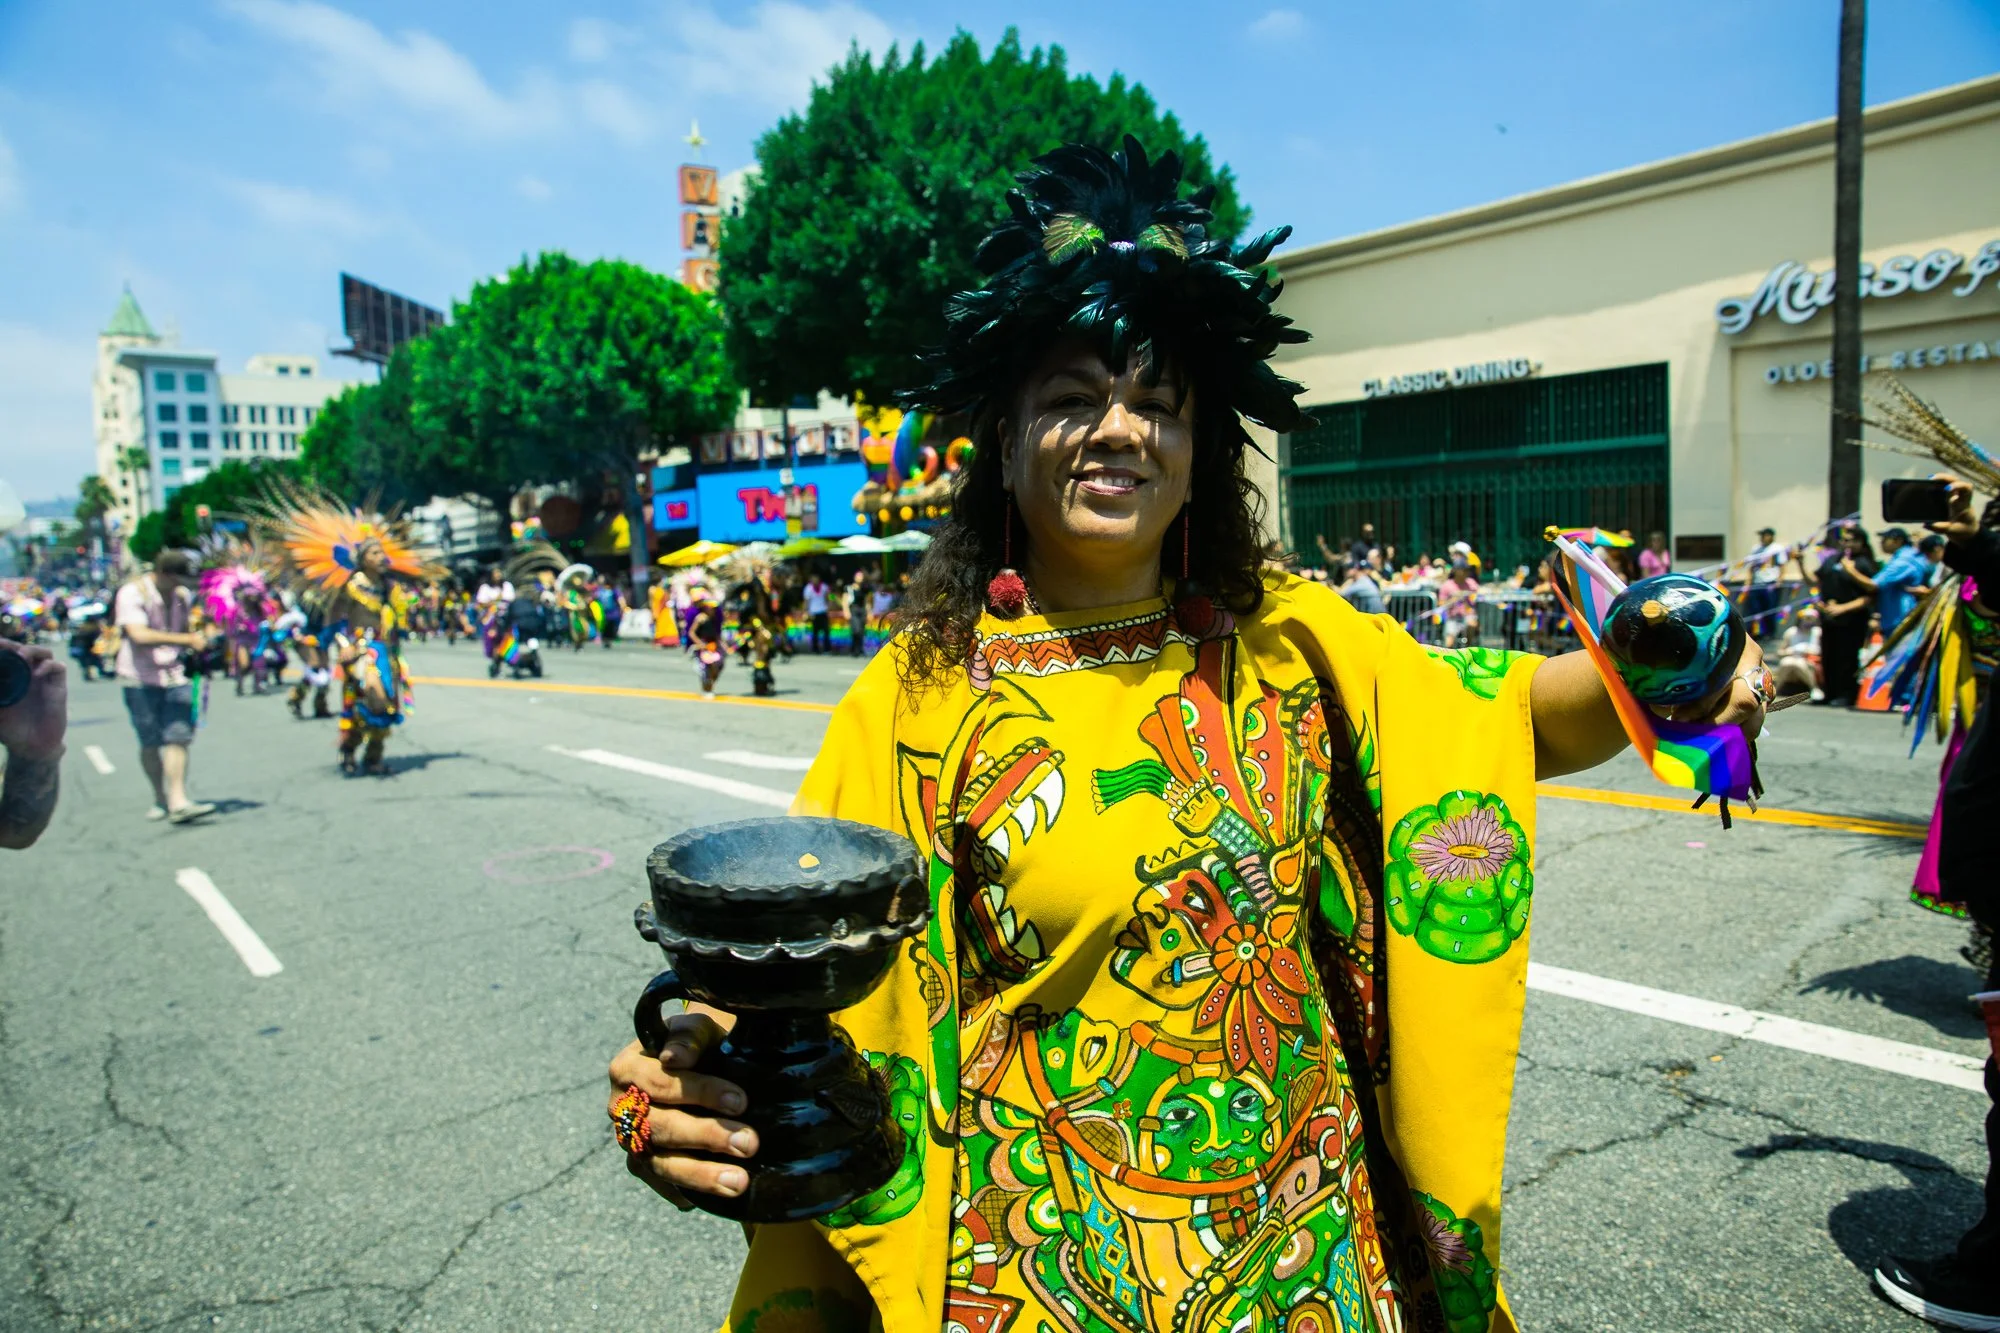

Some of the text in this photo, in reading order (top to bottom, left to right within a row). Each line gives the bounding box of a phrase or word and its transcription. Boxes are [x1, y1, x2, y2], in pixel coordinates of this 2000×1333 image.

[1891, 340, 2000, 370] RESTA
[1361, 358, 1530, 398] CLASSIC DINING
